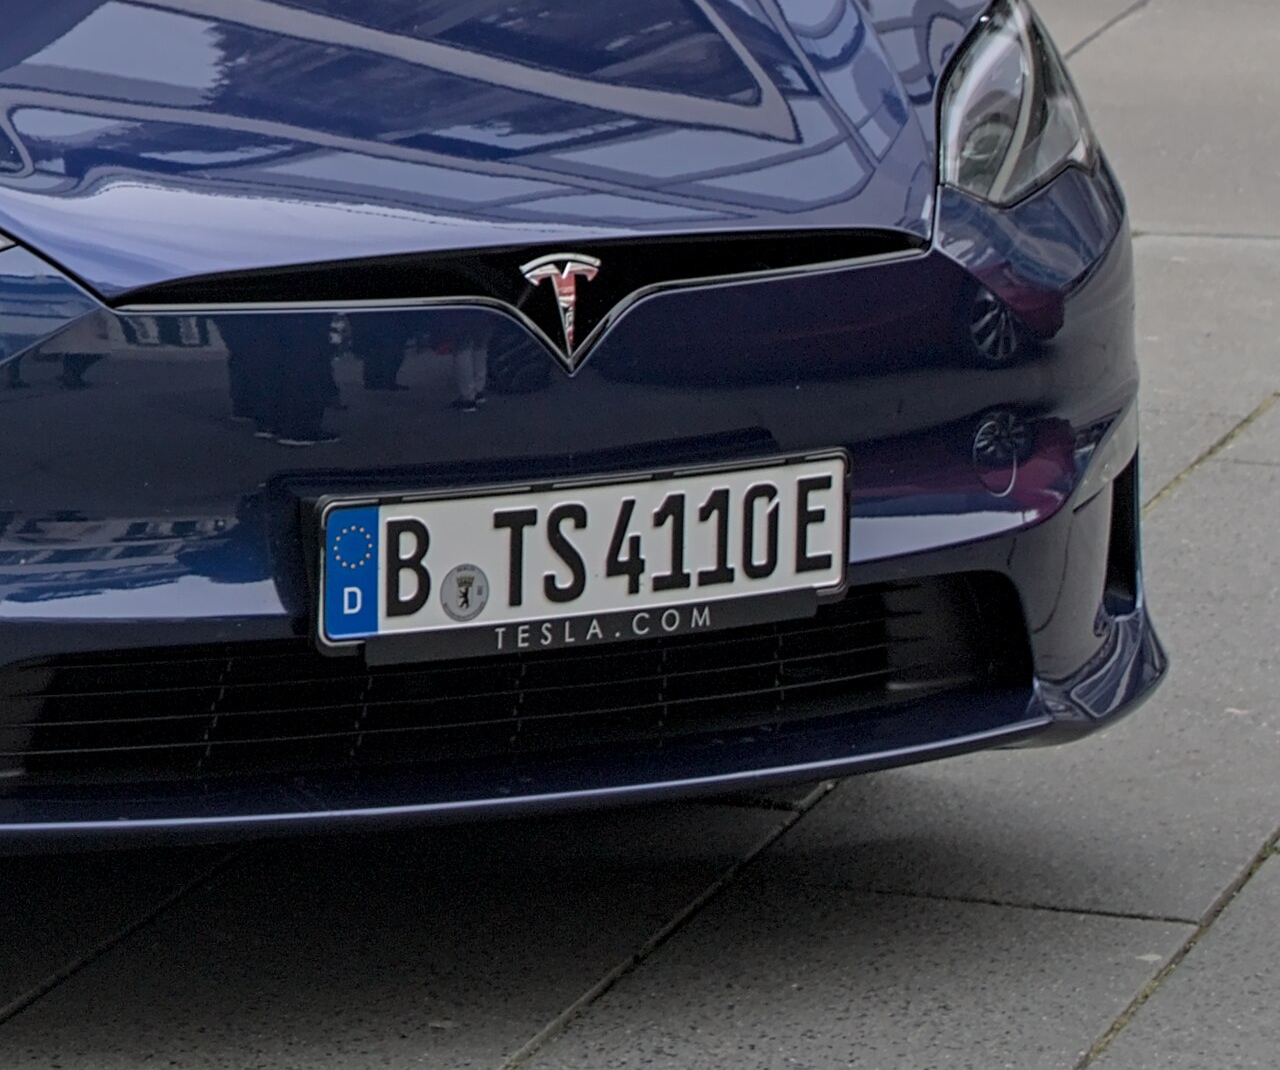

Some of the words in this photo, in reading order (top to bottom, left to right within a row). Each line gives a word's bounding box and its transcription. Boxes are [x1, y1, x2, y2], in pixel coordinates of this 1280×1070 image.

[385, 518, 430, 617] B
[493, 503, 588, 607] TS
[343, 586, 363, 615] D
[495, 606, 711, 649] TESLA.COM
